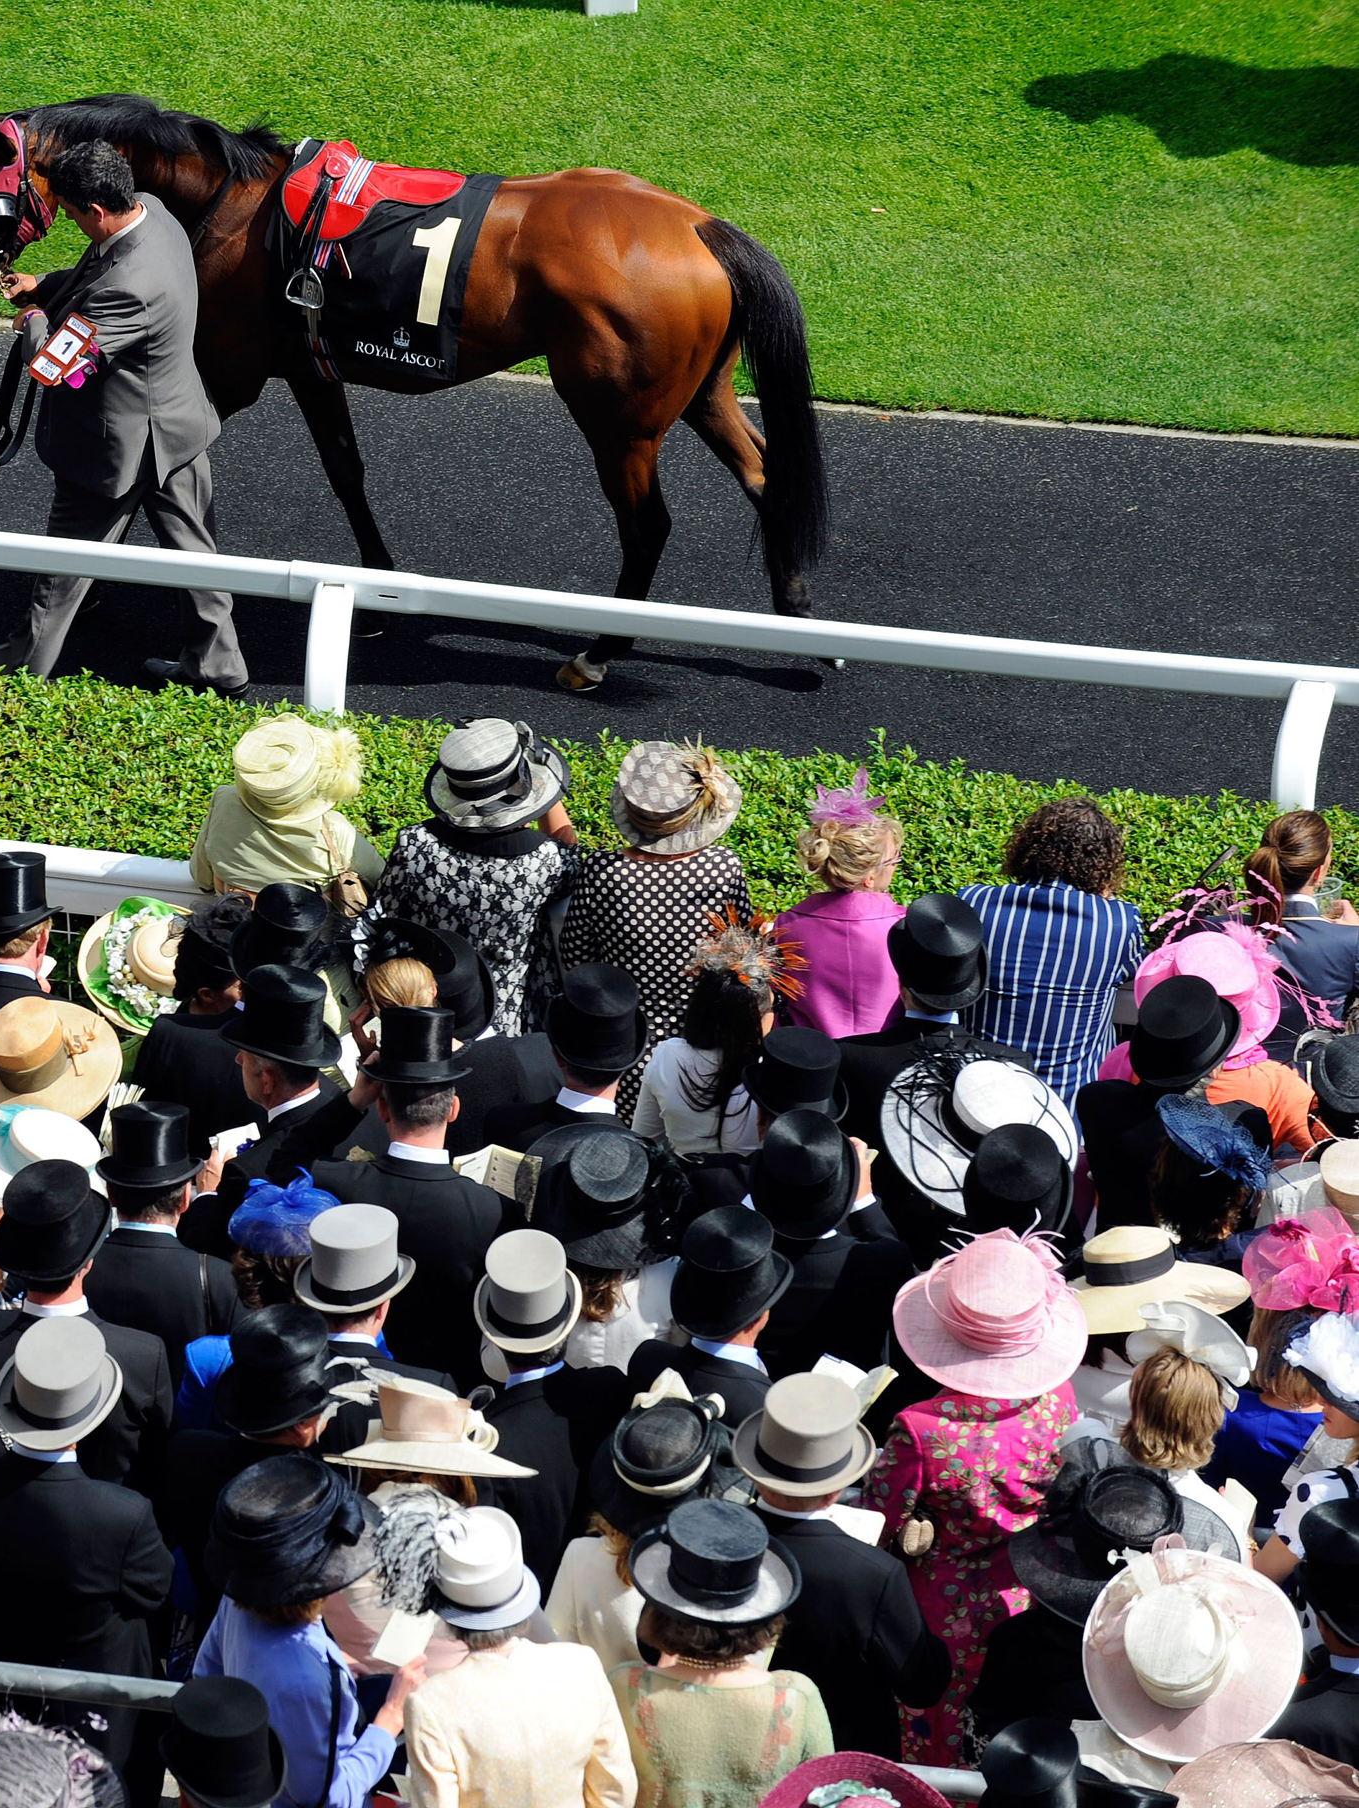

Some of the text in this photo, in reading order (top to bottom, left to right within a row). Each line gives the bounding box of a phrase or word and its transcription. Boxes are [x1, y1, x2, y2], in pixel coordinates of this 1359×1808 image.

[412, 216, 463, 326] 1
[62, 341, 74, 355] 1
[355, 341, 445, 370] ROYAL ASCOT
